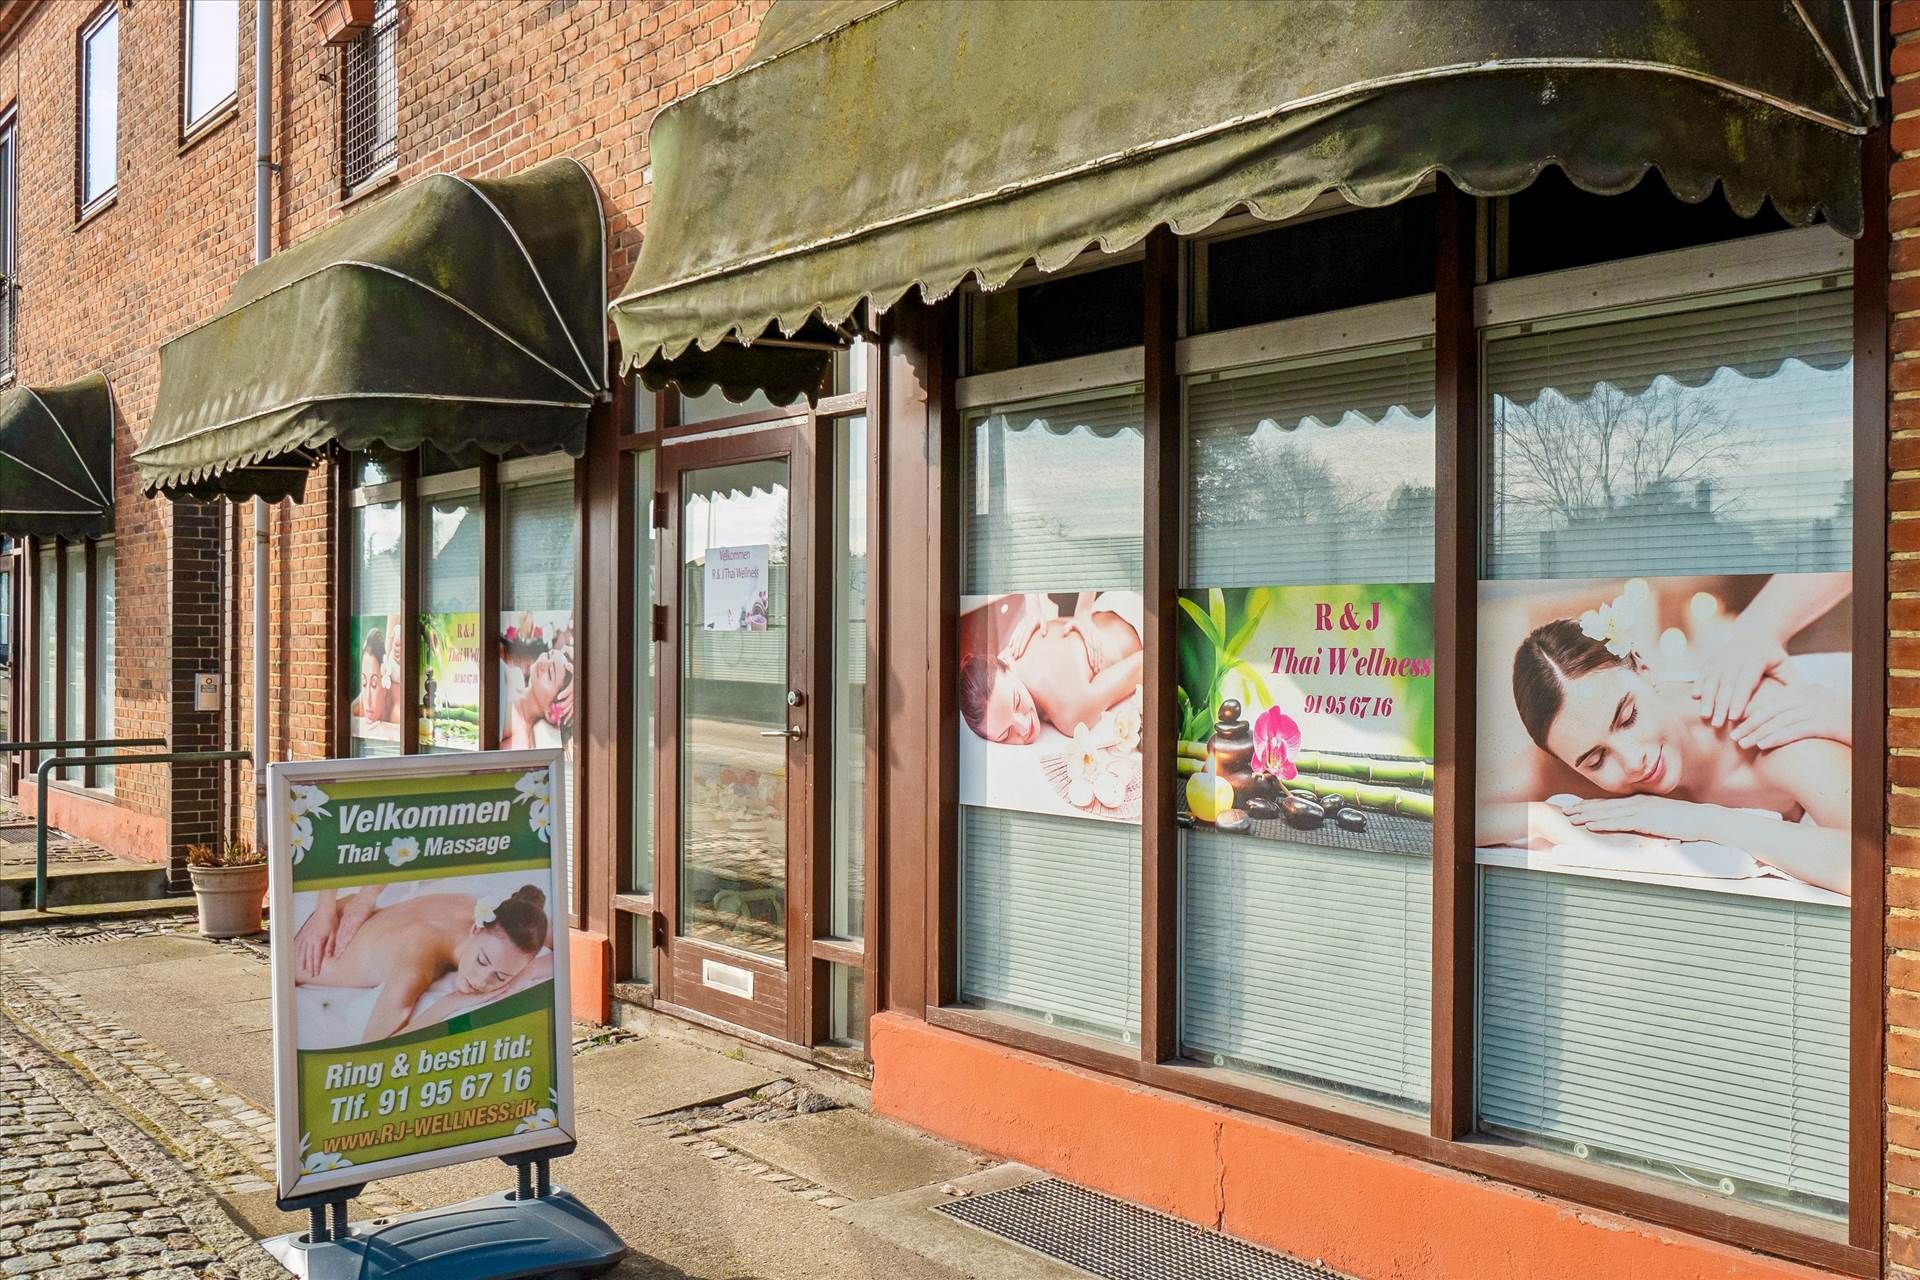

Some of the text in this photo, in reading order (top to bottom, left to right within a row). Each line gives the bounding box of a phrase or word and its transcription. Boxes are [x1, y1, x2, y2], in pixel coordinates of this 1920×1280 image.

[719, 550, 751, 560] Velkommen
[736, 567, 759, 578] Wellness
[1314, 602, 1381, 632] R & J
[1270, 646, 1432, 678] Thai Wellness
[1303, 694, 1394, 719] 91 95 67 16
[338, 798, 511, 834] Velkommen
[336, 833, 511, 866] Thai Massage
[324, 1034, 532, 1093] Ring & bestil tid:
[329, 1065, 532, 1124] Tlf. 91 95 67 16
[322, 1098, 538, 1155] www.RJ-WELLNESS.dk
